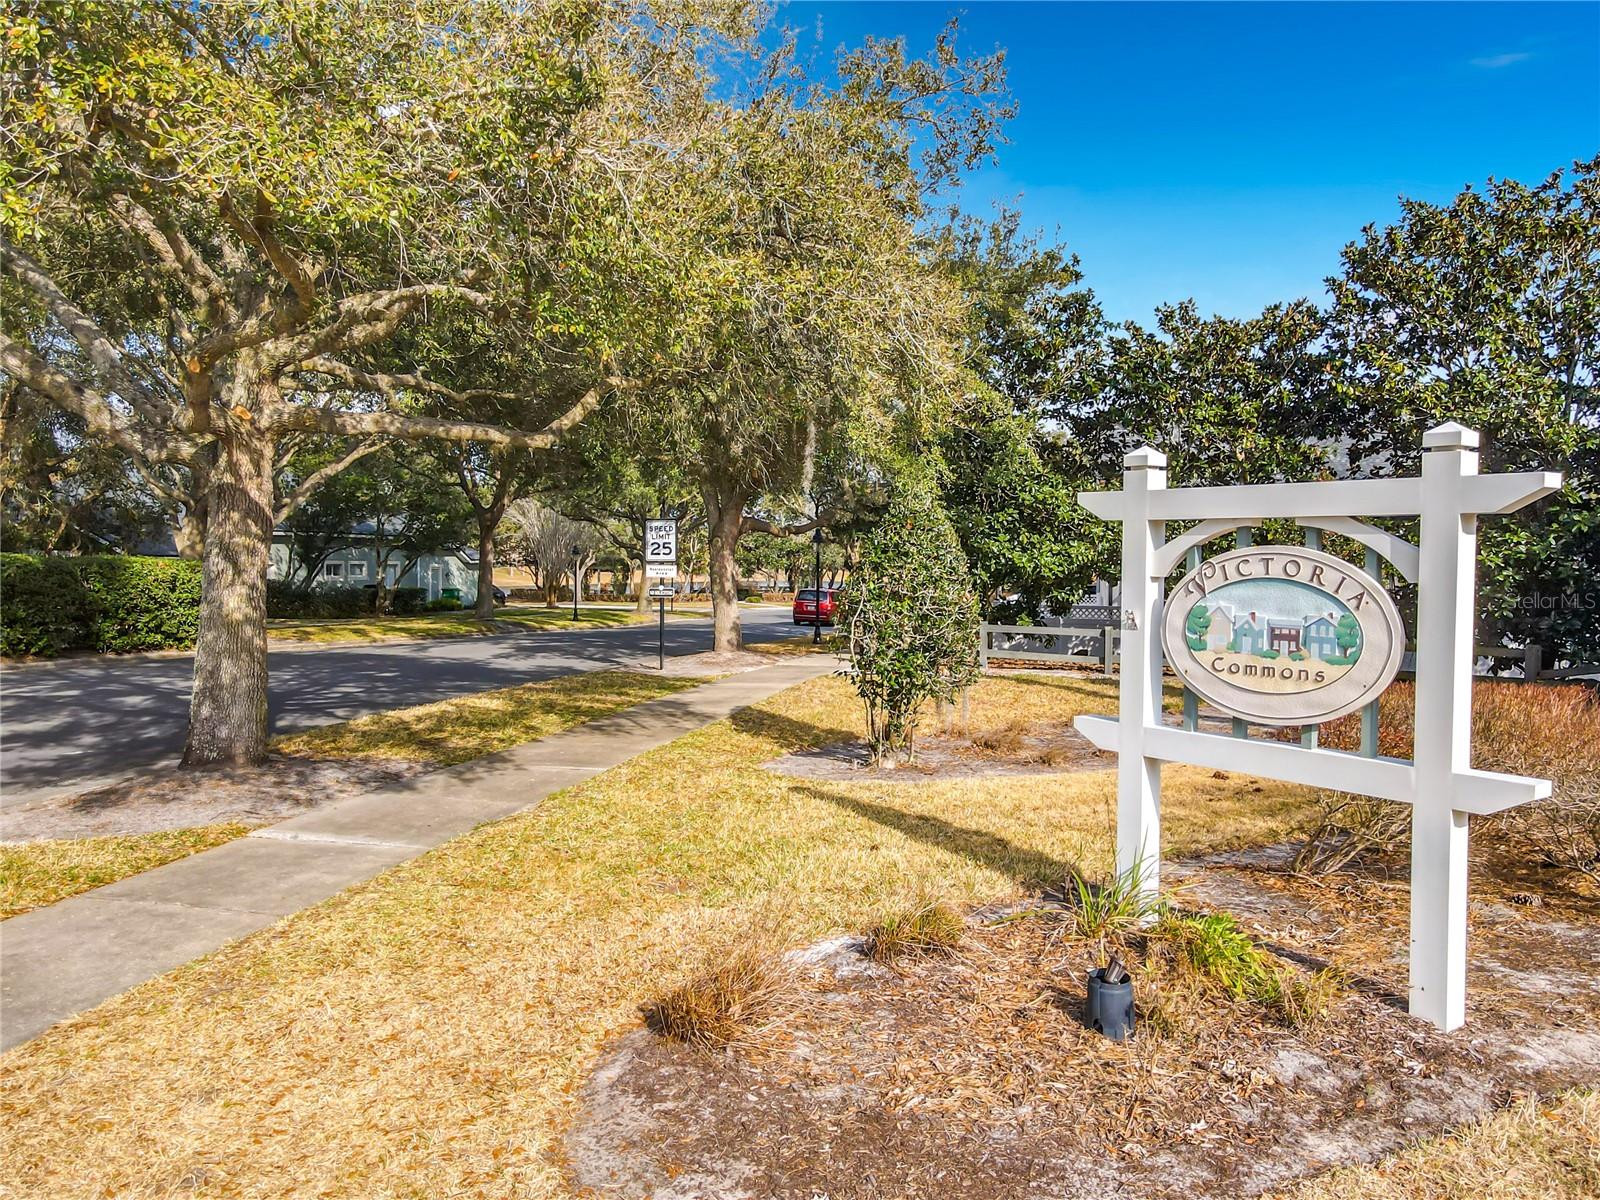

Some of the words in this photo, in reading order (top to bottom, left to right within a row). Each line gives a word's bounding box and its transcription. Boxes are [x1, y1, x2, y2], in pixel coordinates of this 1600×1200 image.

[650, 541, 672, 556] 25
[1185, 557, 1367, 611] VICTORIA
[1211, 656, 1326, 683] Commons
